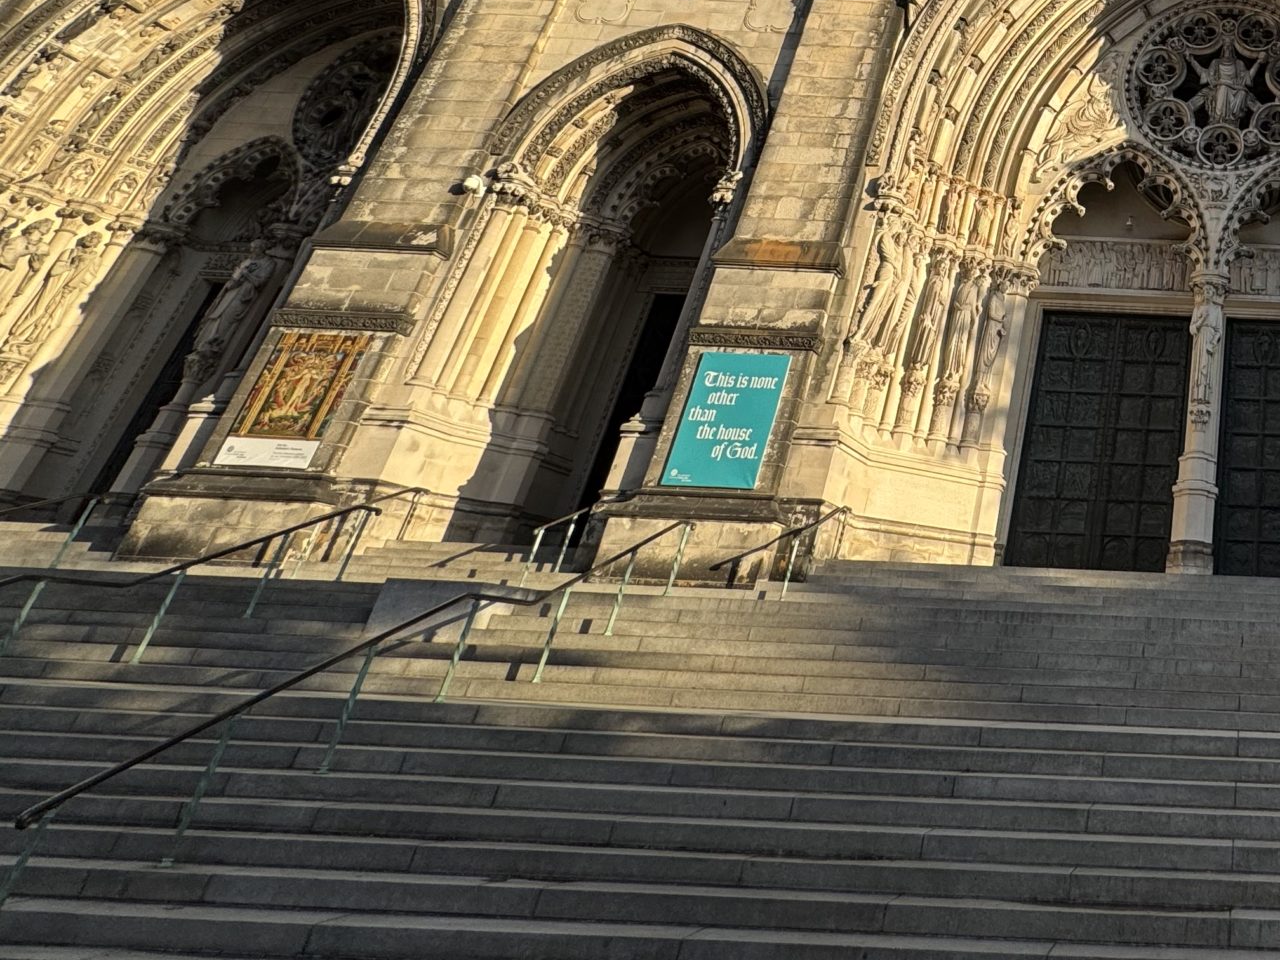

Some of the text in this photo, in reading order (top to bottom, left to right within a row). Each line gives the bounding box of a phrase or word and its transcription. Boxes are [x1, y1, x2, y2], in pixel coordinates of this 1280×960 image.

[704, 370, 779, 389] This is none
[707, 390, 740, 405] other
[688, 407, 717, 421] than
[696, 424, 753, 440] the house
[711, 442, 758, 461] of God.
